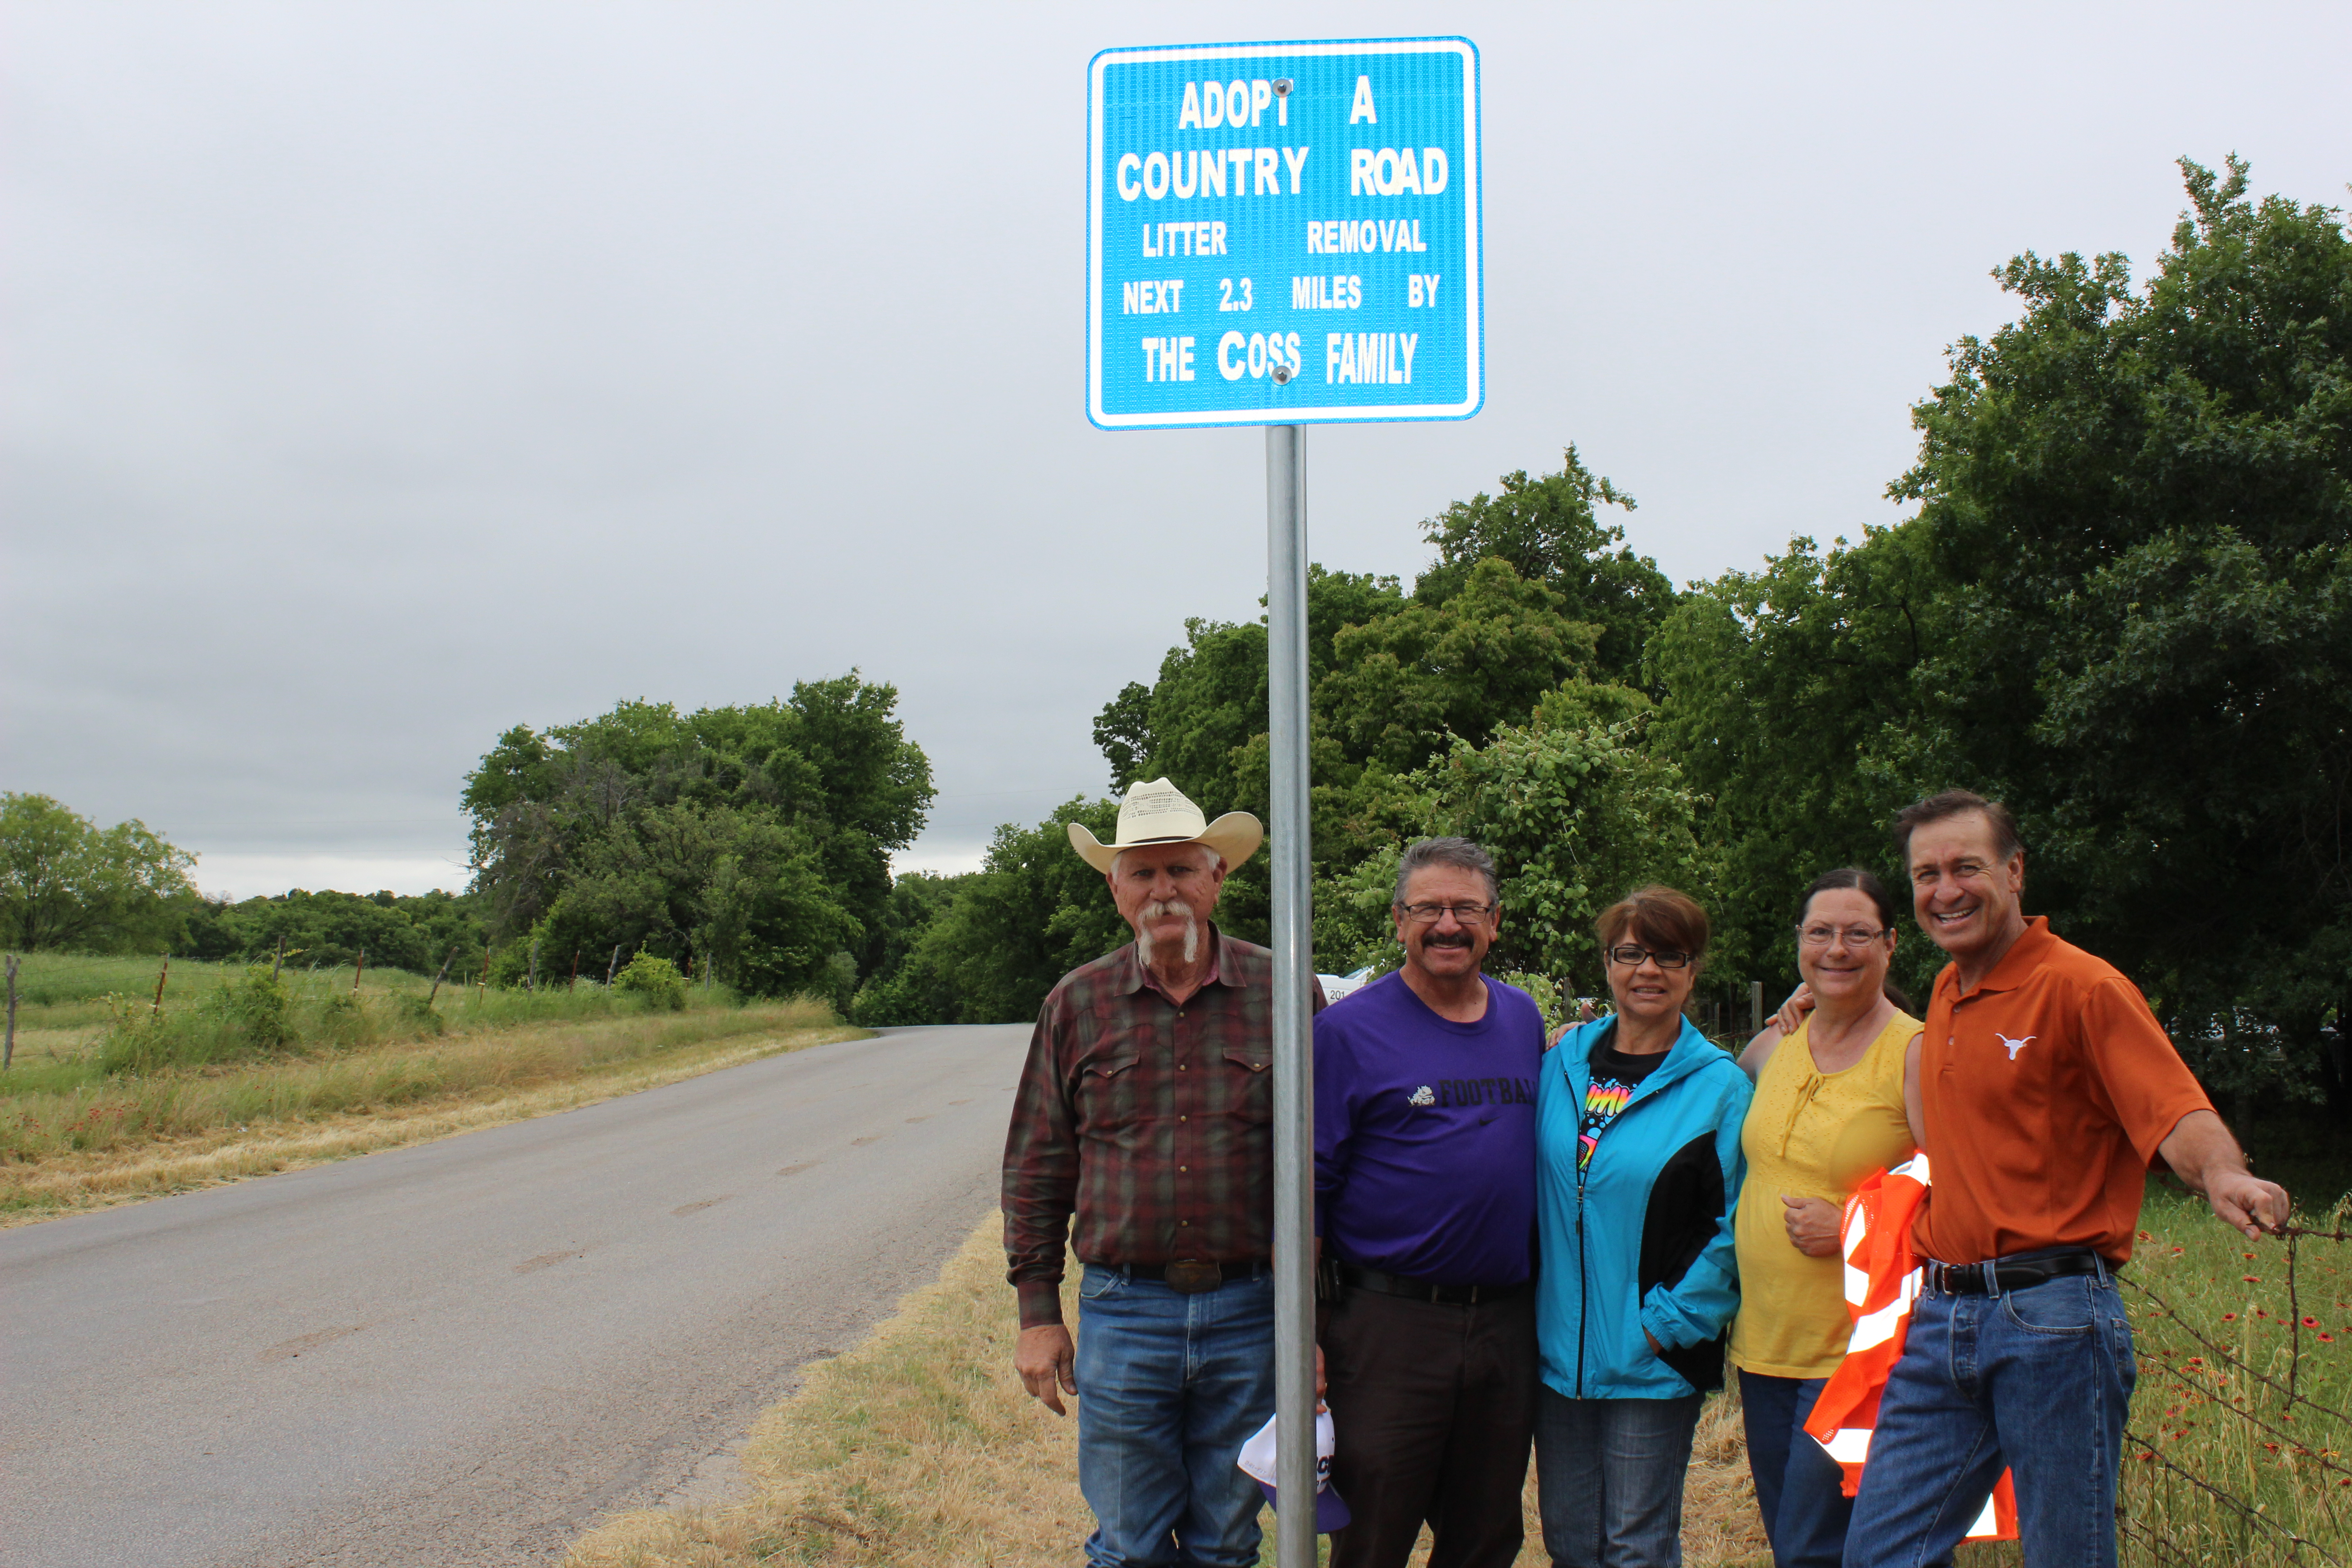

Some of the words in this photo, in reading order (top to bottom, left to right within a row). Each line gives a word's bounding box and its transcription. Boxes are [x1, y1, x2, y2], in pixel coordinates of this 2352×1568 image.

[1179, 78, 1294, 129] ADOPT
[1350, 76, 1377, 124] A
[1117, 147, 1309, 201] COUNTRY
[1351, 148, 1449, 196] ROAD
[1143, 221, 1227, 257] LITTER
[1308, 220, 1426, 254] REMOVAL
[1124, 280, 1184, 314] NEXT
[1219, 278, 1253, 311] 2.3
[1292, 275, 1362, 309] MILES
[1408, 274, 1440, 308] BY
[1142, 337, 1195, 382] THE
[1217, 331, 1302, 382] COSS
[1327, 333, 1418, 384] FAMILY
[1330, 990, 1345, 1000] 201
